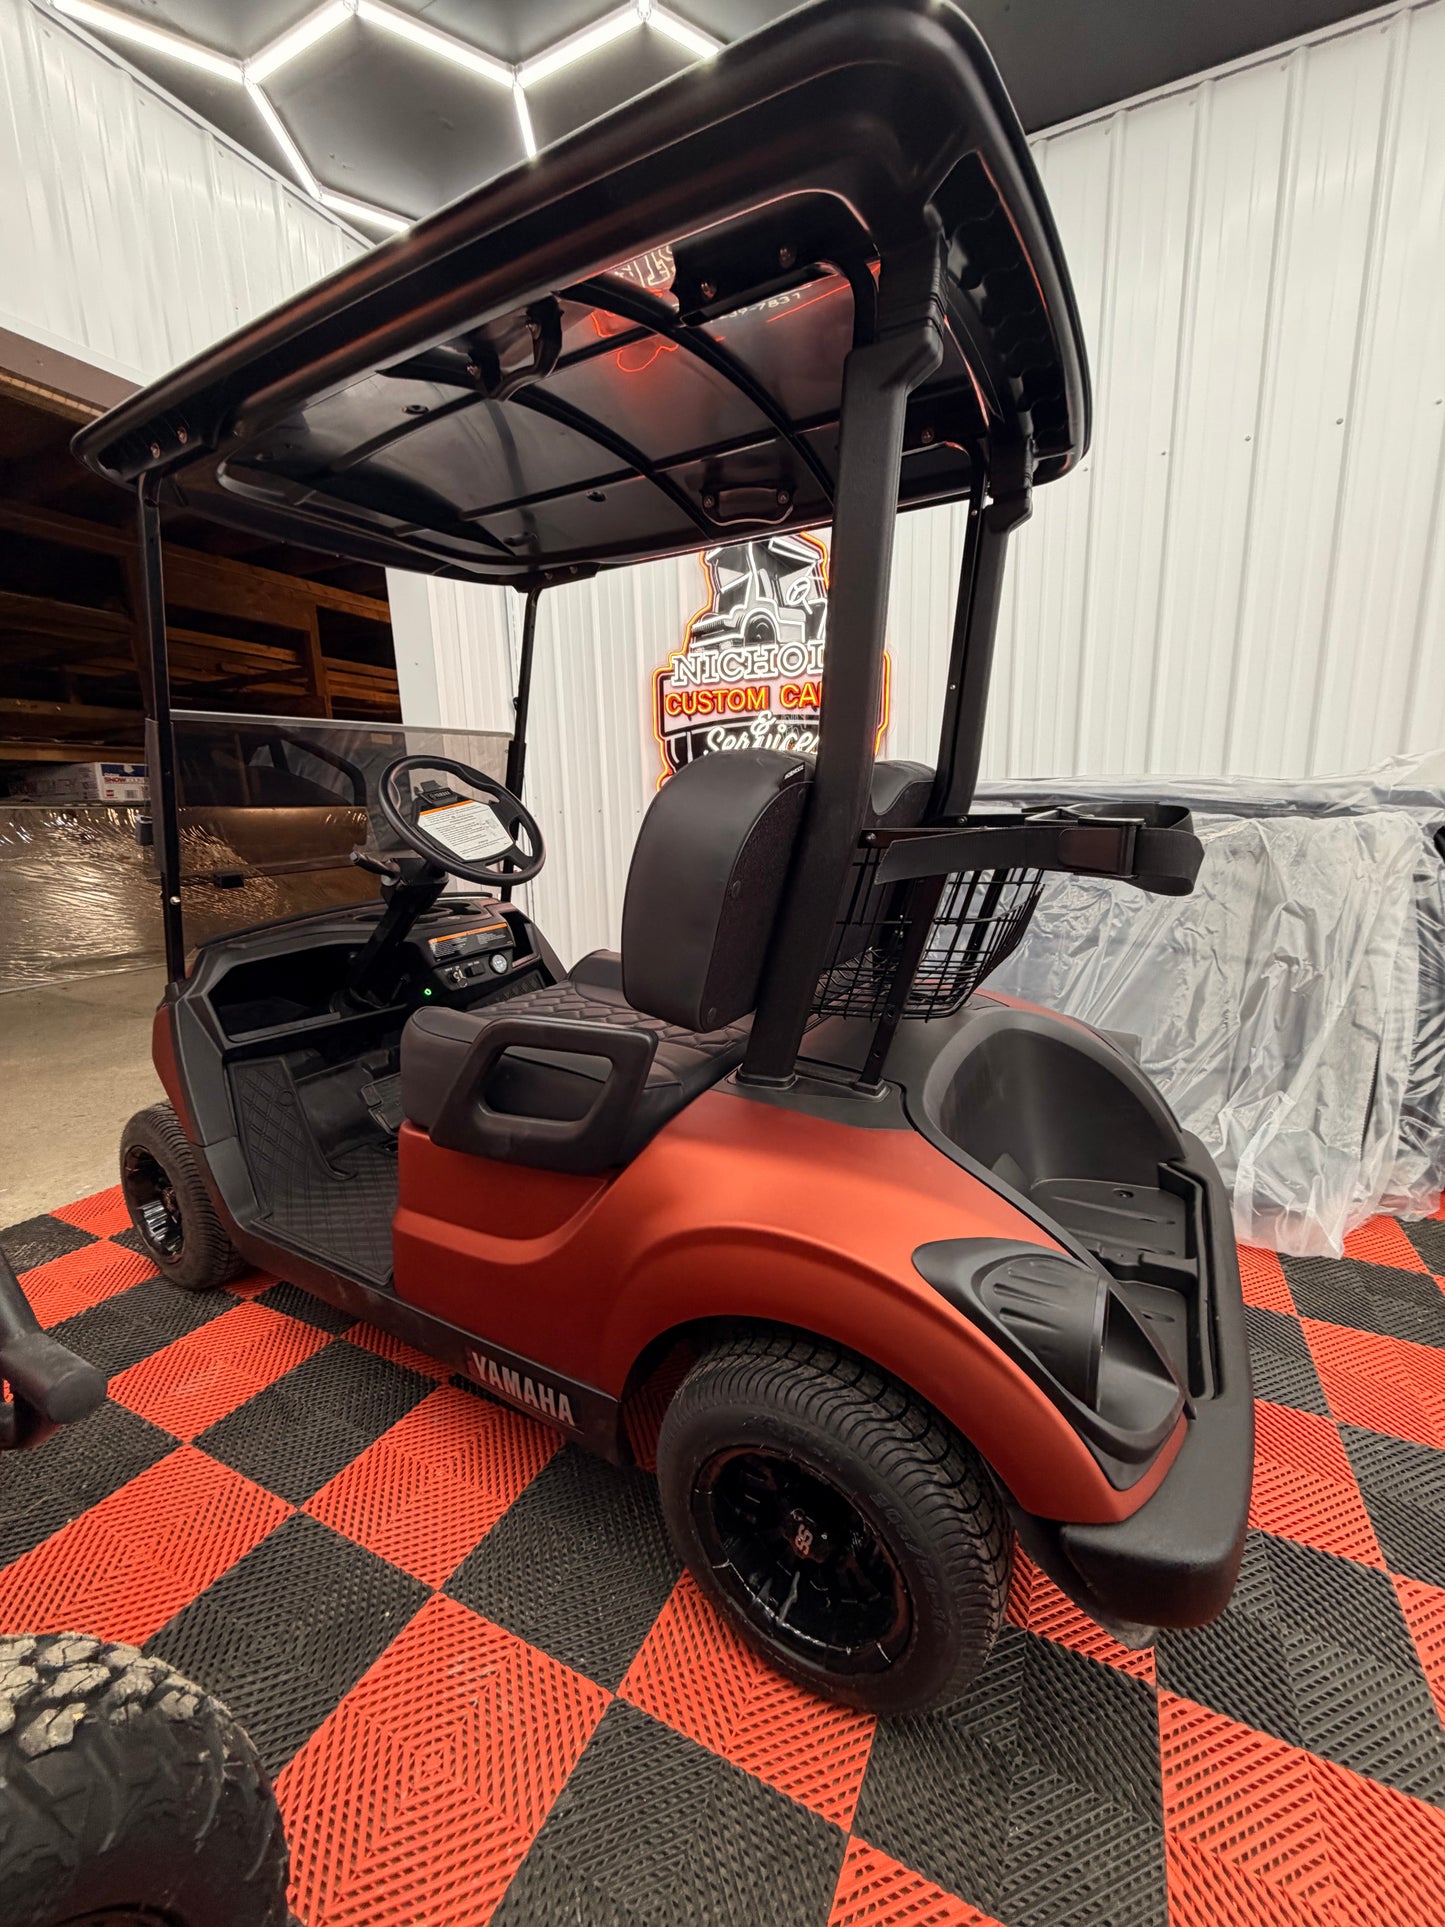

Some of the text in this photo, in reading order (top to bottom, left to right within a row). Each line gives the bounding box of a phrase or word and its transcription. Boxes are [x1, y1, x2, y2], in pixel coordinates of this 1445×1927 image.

[665, 685, 770, 716] CUSTOM
[751, 710, 776, 735] &
[472, 1351, 575, 1426] YAMAHA
